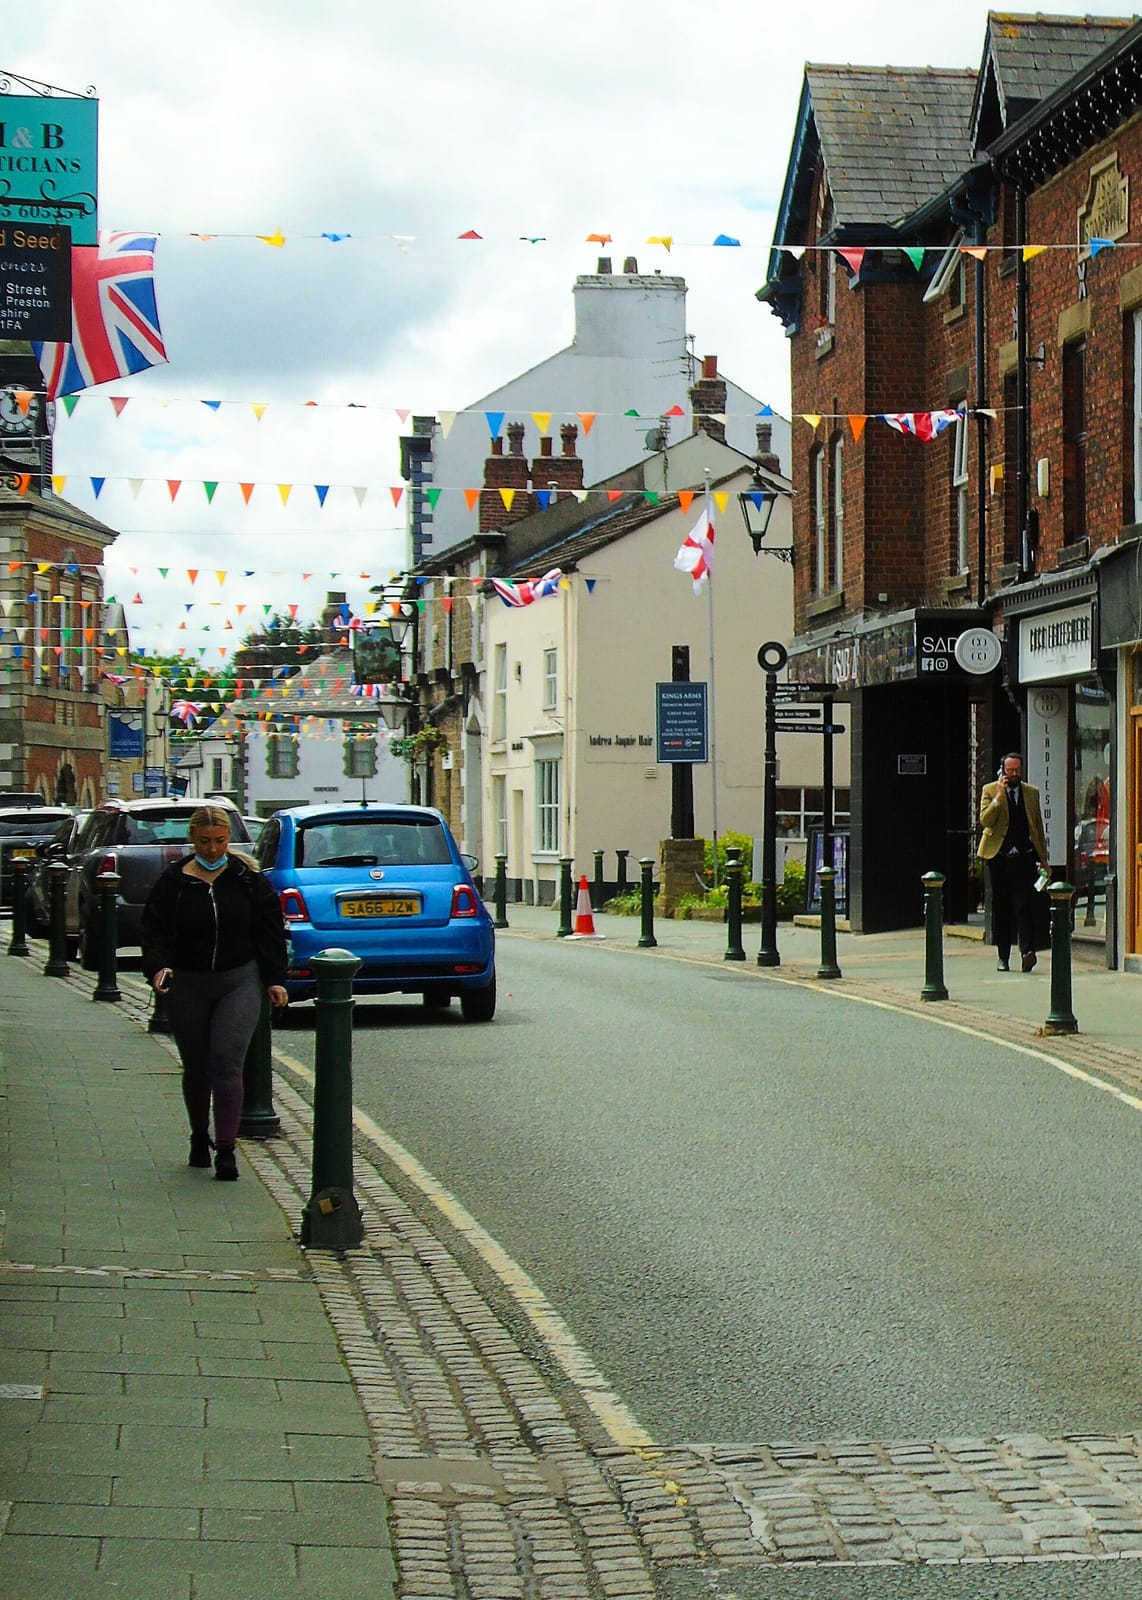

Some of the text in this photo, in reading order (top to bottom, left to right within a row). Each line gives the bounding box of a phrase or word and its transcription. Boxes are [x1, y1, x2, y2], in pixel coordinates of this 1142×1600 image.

[40, 123, 65, 149] B
[6, 282, 48, 296] Street
[6, 296, 50, 308] Preston
[589, 734, 612, 746] Andrea
[638, 735, 653, 746] Hair
[347, 902, 413, 915] SA66 JZW
